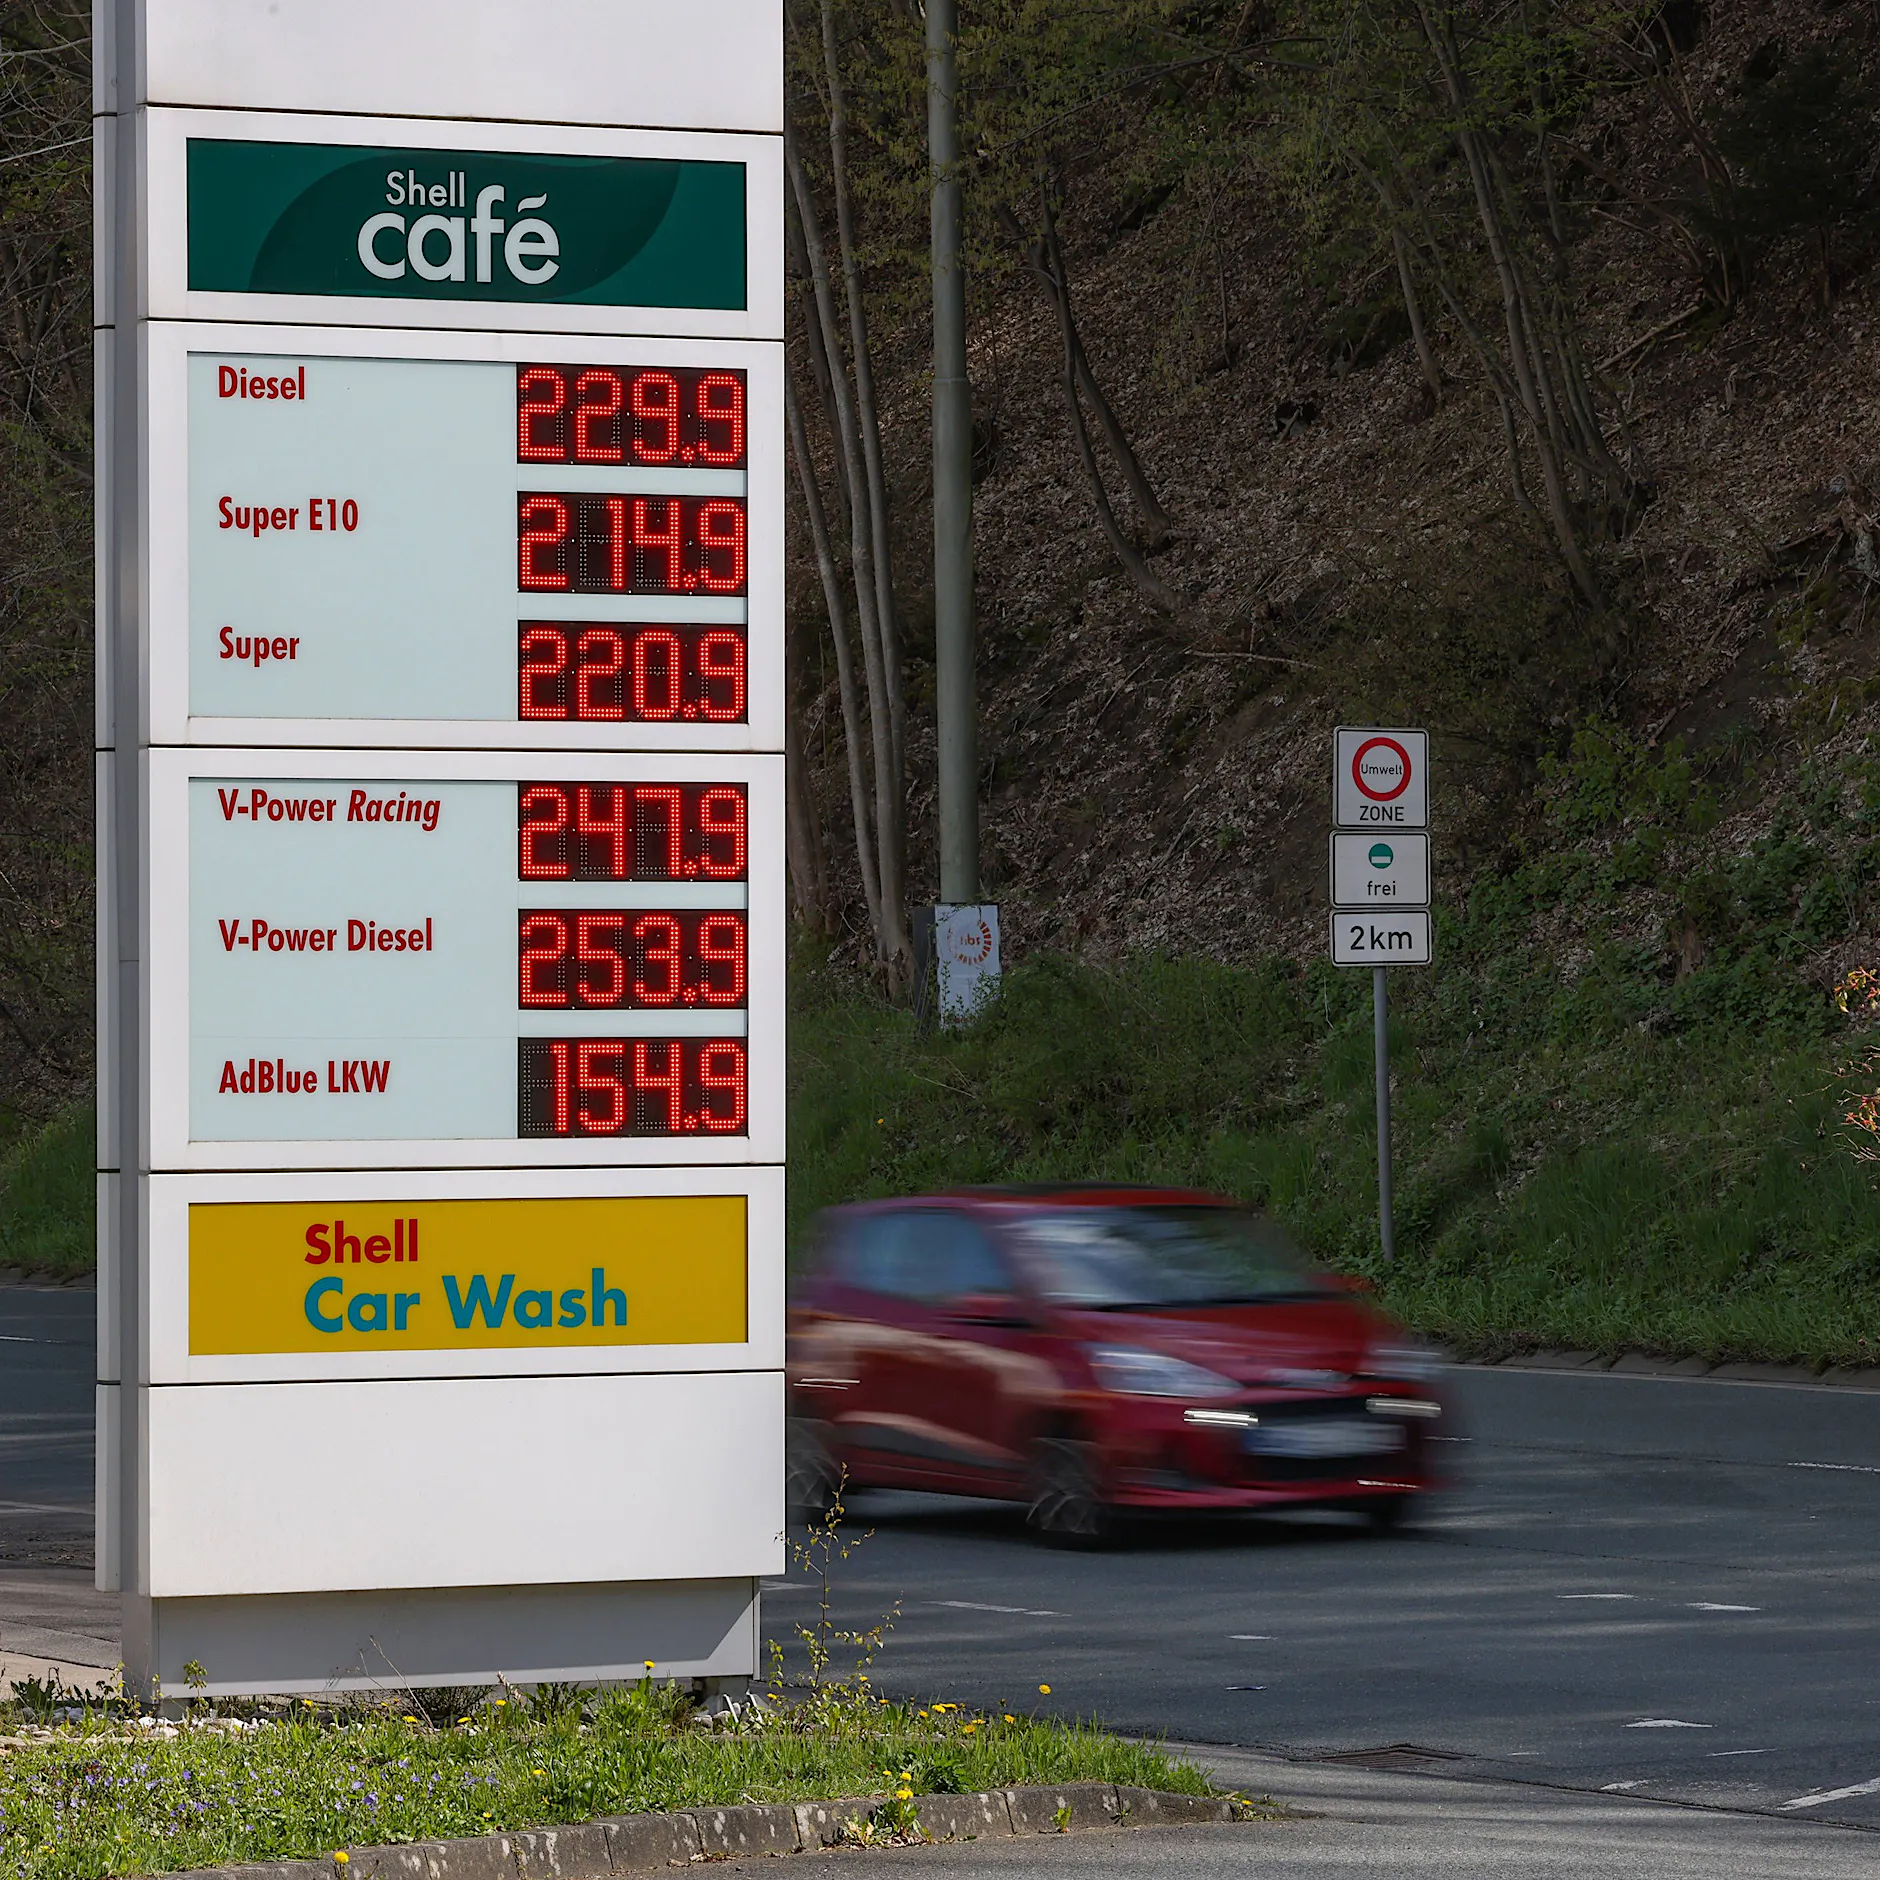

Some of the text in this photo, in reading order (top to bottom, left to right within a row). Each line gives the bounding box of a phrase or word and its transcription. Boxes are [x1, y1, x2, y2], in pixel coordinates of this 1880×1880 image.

[386, 170, 465, 207] Shell
[357, 185, 560, 284] café
[218, 365, 305, 400] Diesel
[520, 368, 743, 463] 229.9
[218, 496, 359, 538] Super E10
[521, 498, 745, 590] 214.9
[218, 626, 300, 667] Super
[521, 630, 744, 720] 220.9
[1361, 763, 1403, 776] Umwelt
[218, 788, 441, 831] V-Power Racing
[1359, 805, 1405, 822] ZONE
[521, 787, 745, 876] 247.9
[1367, 881, 1397, 896] frei
[218, 918, 432, 952] V-Power Diesel
[521, 915, 744, 1004] 253.9
[219, 1059, 391, 1093] AdBlue LKW
[551, 1042, 745, 1132] 154.9
[304, 1219, 418, 1265] Shell
[304, 1268, 628, 1333] Car Wash
